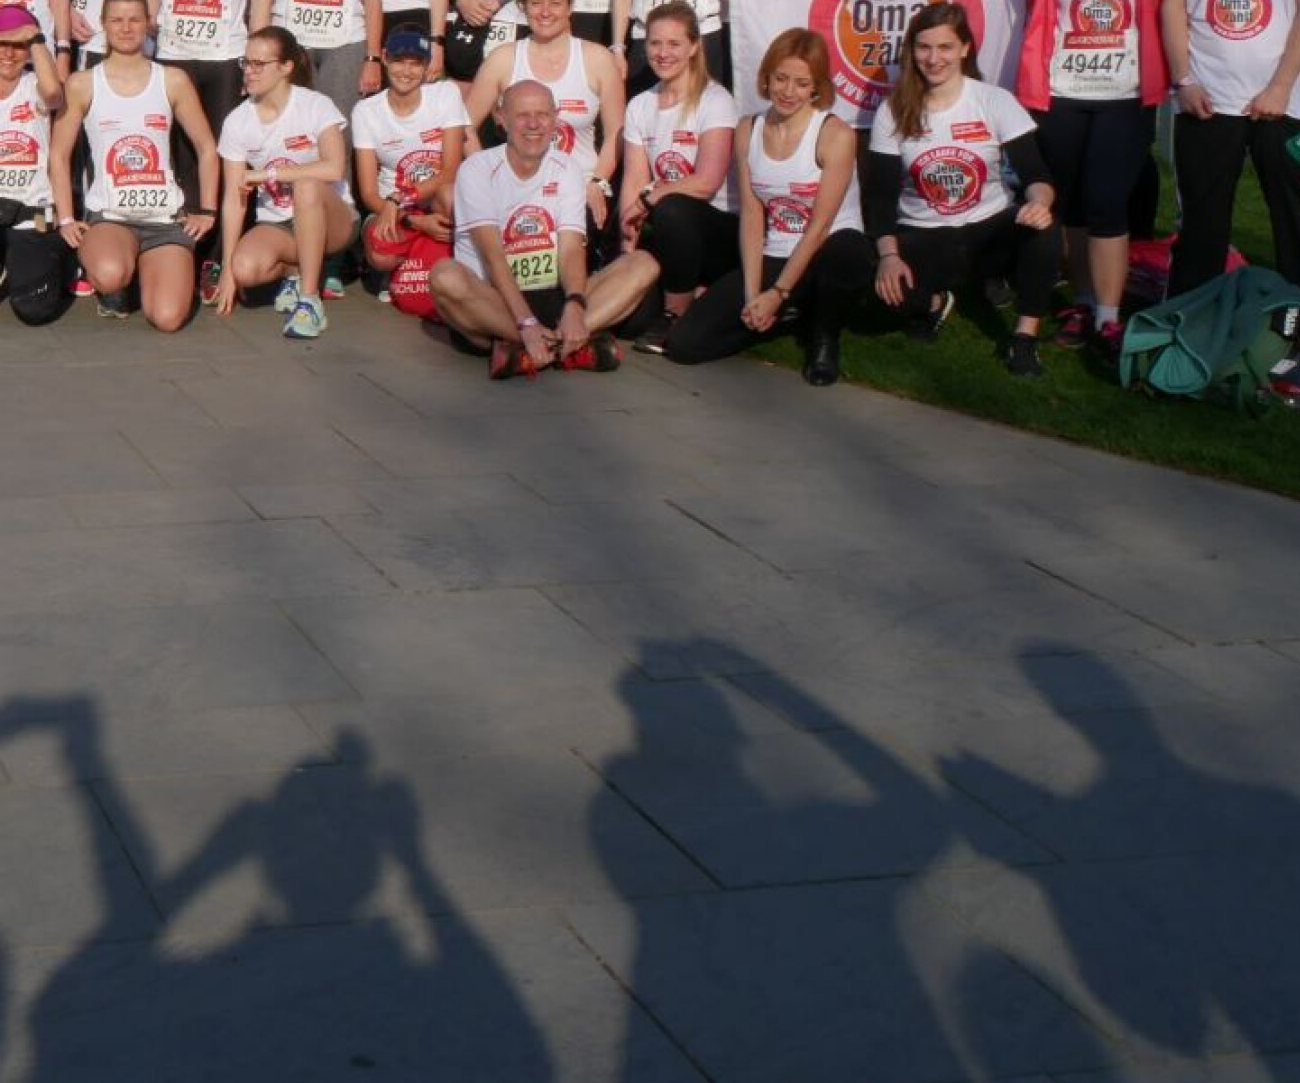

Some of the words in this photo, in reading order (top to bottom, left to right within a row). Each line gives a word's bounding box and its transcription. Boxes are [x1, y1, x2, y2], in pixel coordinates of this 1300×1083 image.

[293, 7, 343, 28] 30973
[1083, 7, 1112, 19] Oma
[175, 18, 218, 39] 8279
[1062, 52, 1126, 73] 49447
[927, 173, 964, 186] Oma
[118, 189, 168, 207] 28332
[511, 253, 554, 278] 4822
